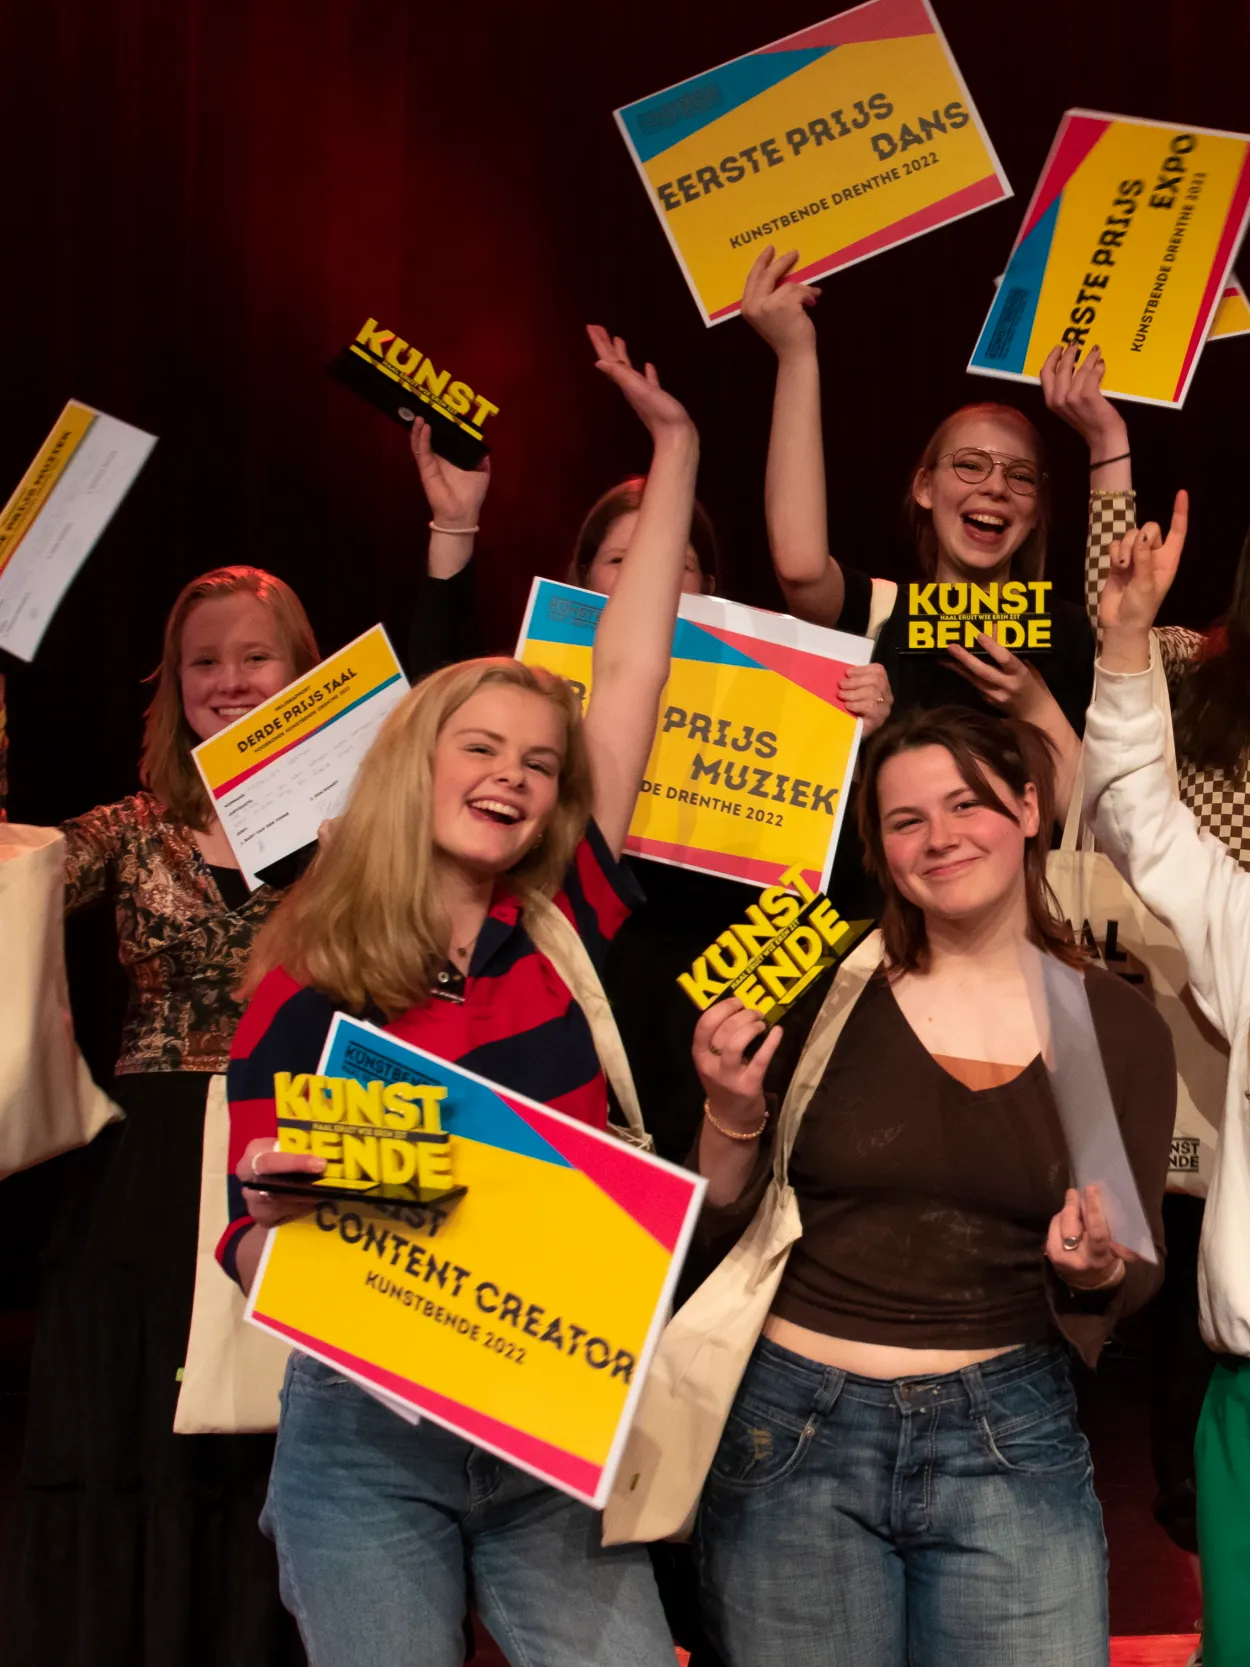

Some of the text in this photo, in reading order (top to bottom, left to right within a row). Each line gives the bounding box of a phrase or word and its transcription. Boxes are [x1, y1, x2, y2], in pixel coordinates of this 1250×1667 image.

[657, 137, 784, 211] EERSTE
[785, 93, 894, 156] PRIJS
[870, 102, 969, 161] DANS
[1149, 134, 1197, 209] EXPO
[729, 152, 940, 249] KUNSTBENDE DRENTHE 2022
[1061, 178, 1145, 363] RSTE PRIJS
[1130, 264, 1173, 352] KUNSTBENDE
[356, 317, 500, 427] KUNST
[909, 581, 1052, 615] KUNST
[236, 667, 358, 754] DERDE PRIJS TAAL
[662, 706, 778, 758] PRIJS
[666, 786, 742, 817] DRENTHE
[745, 807, 785, 827] 2022
[690, 752, 839, 815] MUZIEK
[676, 863, 817, 1011] KUNST
[733, 898, 850, 1015] ENDE
[274, 1071, 448, 1135] KUNST
[315, 1201, 471, 1297] CONTENT
[475, 1282, 636, 1384] CREATOR
[365, 1270, 527, 1365] KUNSTBENDE 2022
